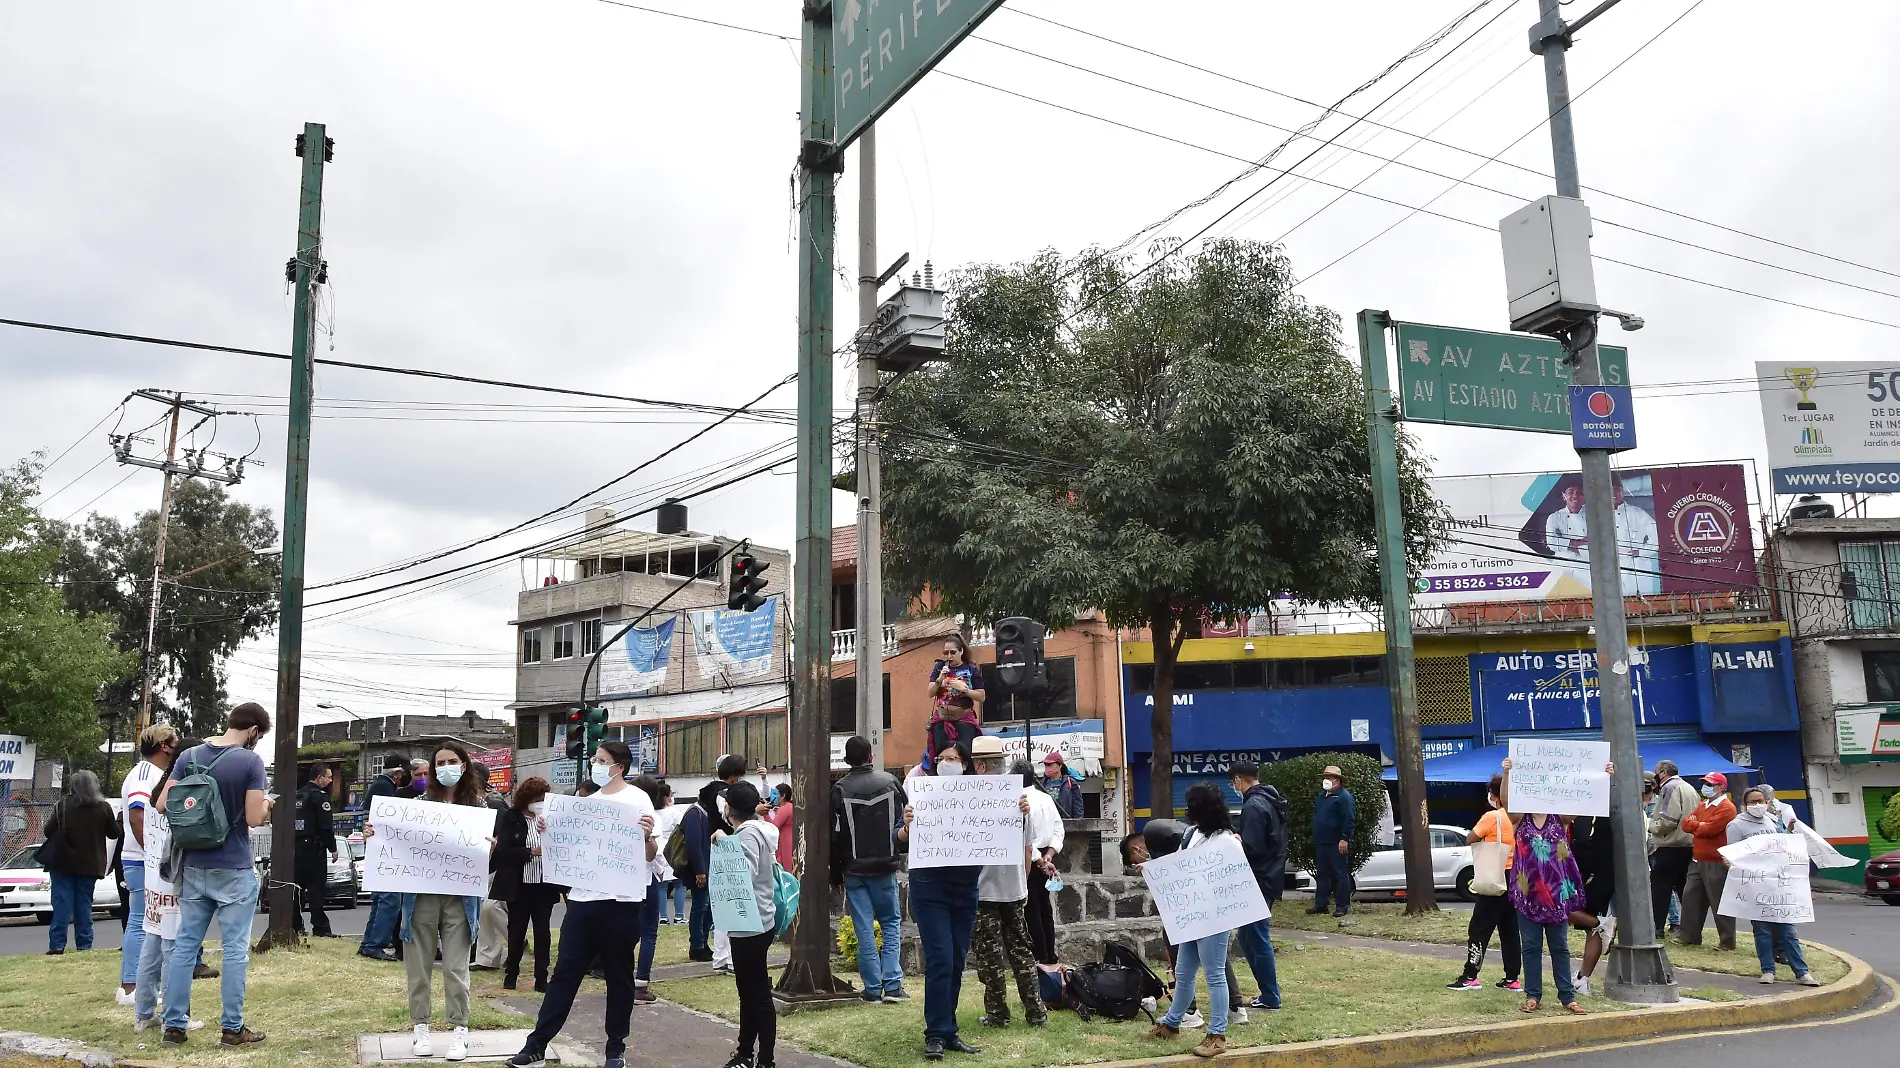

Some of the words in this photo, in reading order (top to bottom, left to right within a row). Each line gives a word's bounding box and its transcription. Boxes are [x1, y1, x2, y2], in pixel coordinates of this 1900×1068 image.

[1441, 345, 1472, 368] AV
[1413, 380, 1435, 402] AV
[1449, 382, 1517, 411] ESTADIO
[1783, 413, 1801, 422] 1er.
[1803, 413, 1835, 422] LUGAR
[1872, 408, 1885, 417] DE
[1583, 421, 1612, 430] BOTÓN
[1869, 421, 1883, 429] EN
[1794, 445, 1832, 454] Olimpiada
[1864, 439, 1888, 448] Jardín
[1785, 470, 1900, 488] www.teyoco
[1668, 494, 1695, 519] OLIVERIO
[1696, 492, 1735, 517] CROMWELL
[1691, 546, 1722, 554] COLEGIO
[1470, 558, 1514, 568] Turismo
[1435, 579, 1451, 589] 55
[1454, 578, 1487, 588] 8526
[1497, 576, 1529, 587] 5362
[1496, 652, 1544, 671] AUTO
[1712, 650, 1775, 672] AL-MI
[1458, 743, 1464, 751] Y
[1516, 743, 1532, 757] EL
[1537, 745, 1573, 758] PUEBLO
[1578, 747, 1595, 760] DE
[1515, 760, 1544, 771] SANTA
[1548, 762, 1582, 774] URSULA
[913, 780, 934, 793] LAS
[942, 779, 993, 793] COLONIAS
[996, 779, 1012, 792] DE
[1555, 776, 1569, 785] DE
[1573, 776, 1590, 785] LOS
[549, 797, 565, 812] EN
[916, 797, 964, 812] COYOACAN
[968, 797, 1018, 811] QUEREMOS
[546, 815, 606, 832] QUEREMOS
[610, 823, 641, 841] AREAS
[916, 815, 943, 829] AGUA
[950, 815, 955, 827] Y
[380, 825, 444, 845] DECIDE
[457, 830, 479, 847] NO
[918, 832, 933, 844] NO
[941, 831, 994, 844] PROYECTO
[548, 832, 590, 846] VERDES
[597, 838, 602, 850] Y
[608, 839, 633, 857] AGUA
[379, 845, 400, 859] AL
[410, 847, 476, 868] PROYECTO
[549, 847, 568, 859] NO
[576, 849, 588, 862] AL
[597, 855, 637, 875] PROYECTO
[916, 847, 962, 860] ESTADIO
[968, 847, 1008, 858] AZTECA
[554, 862, 598, 881] AZTECA
[1147, 866, 1169, 880] LOS
[1173, 850, 1224, 871] VECINOS
[377, 862, 435, 879] ESTADIO
[441, 870, 482, 887] AZTECA
[1741, 869, 1767, 886] DICE
[1156, 877, 1196, 895] UNIDOS
[1165, 892, 1187, 911] NO
[1193, 891, 1209, 904] AL
[1735, 893, 1748, 902] AL
